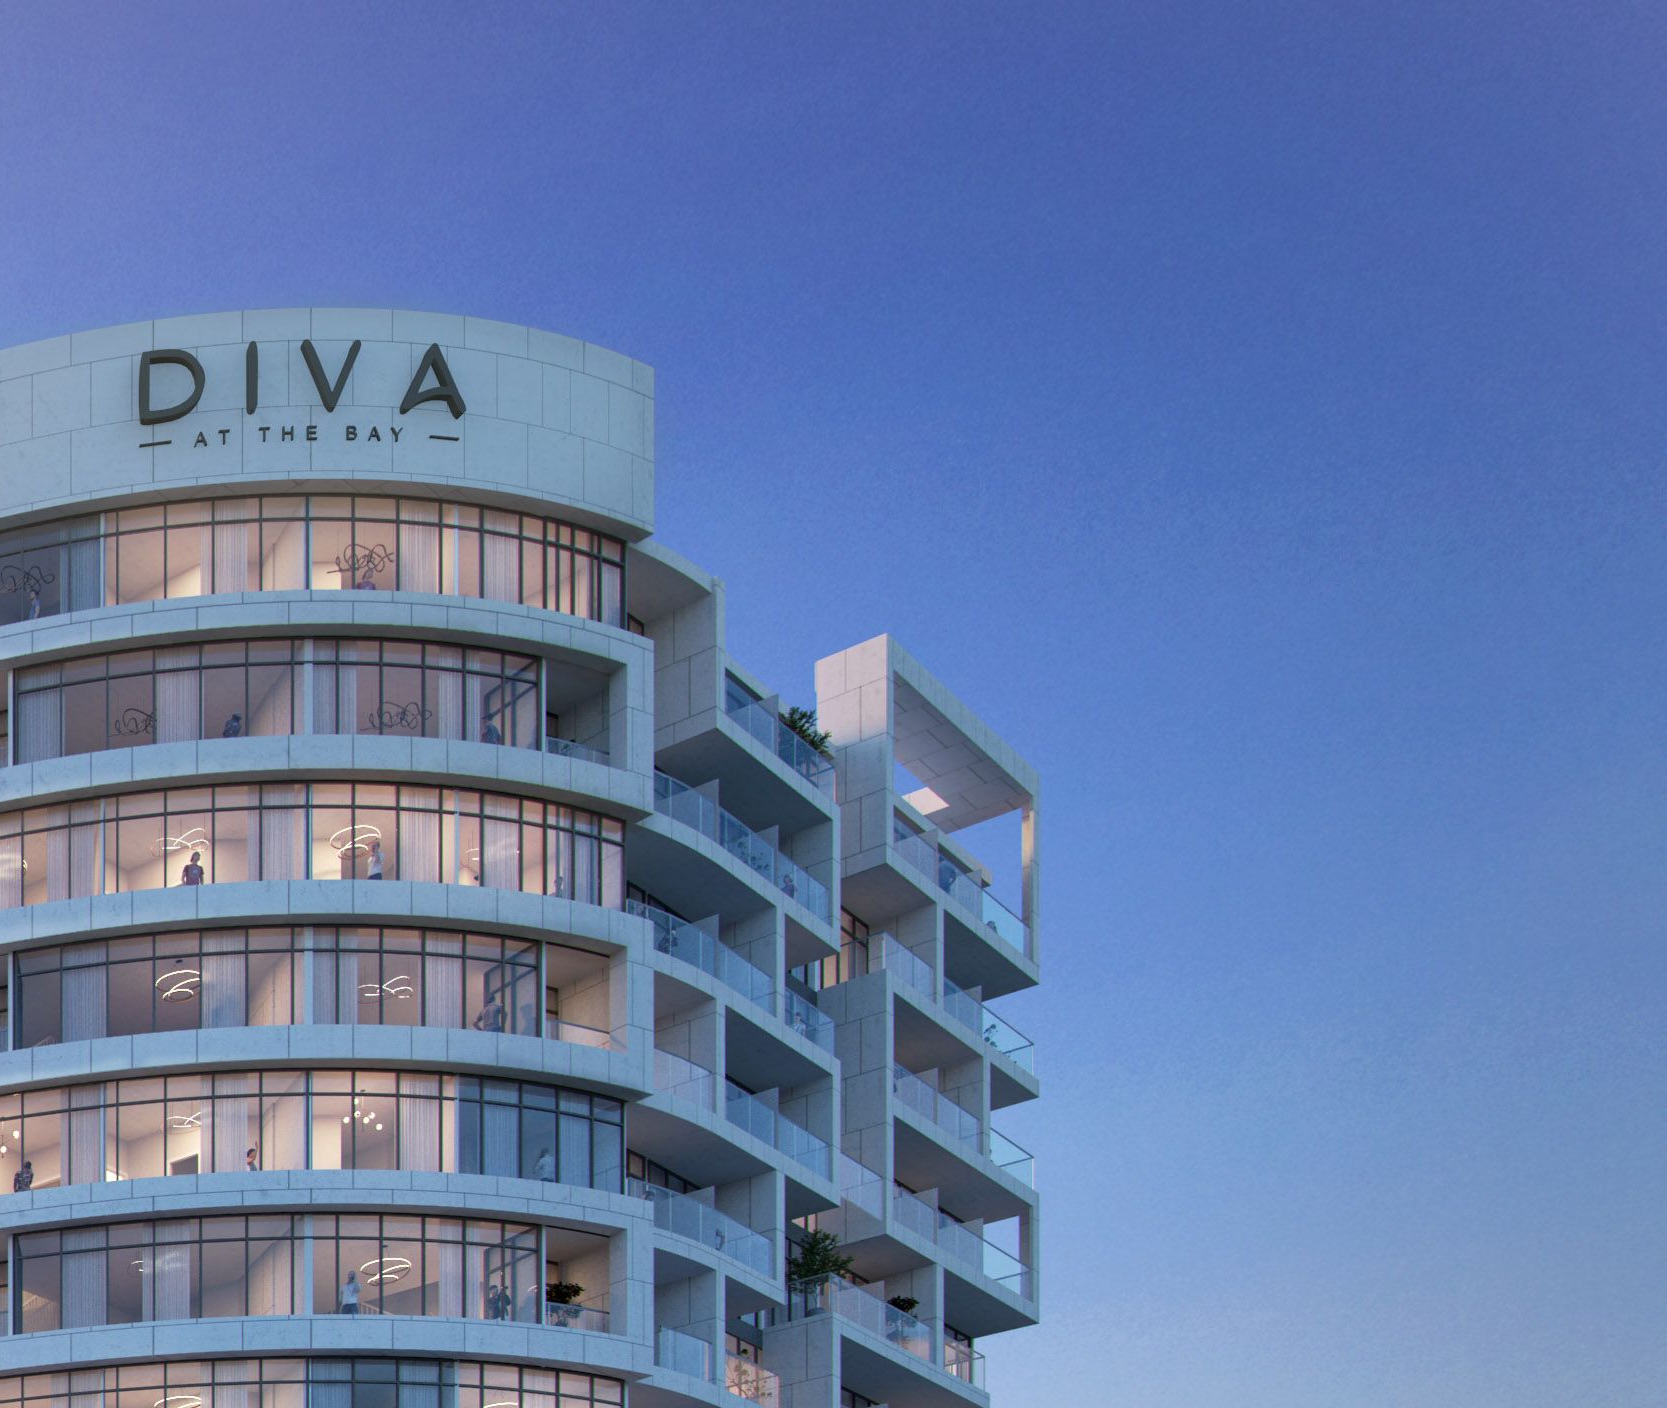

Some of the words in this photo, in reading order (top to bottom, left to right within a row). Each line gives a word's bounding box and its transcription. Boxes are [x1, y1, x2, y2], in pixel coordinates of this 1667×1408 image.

[139, 339, 467, 425] DIVA
[193, 428, 231, 448] AT
[258, 425, 318, 442] THE
[346, 425, 403, 443] BAY
